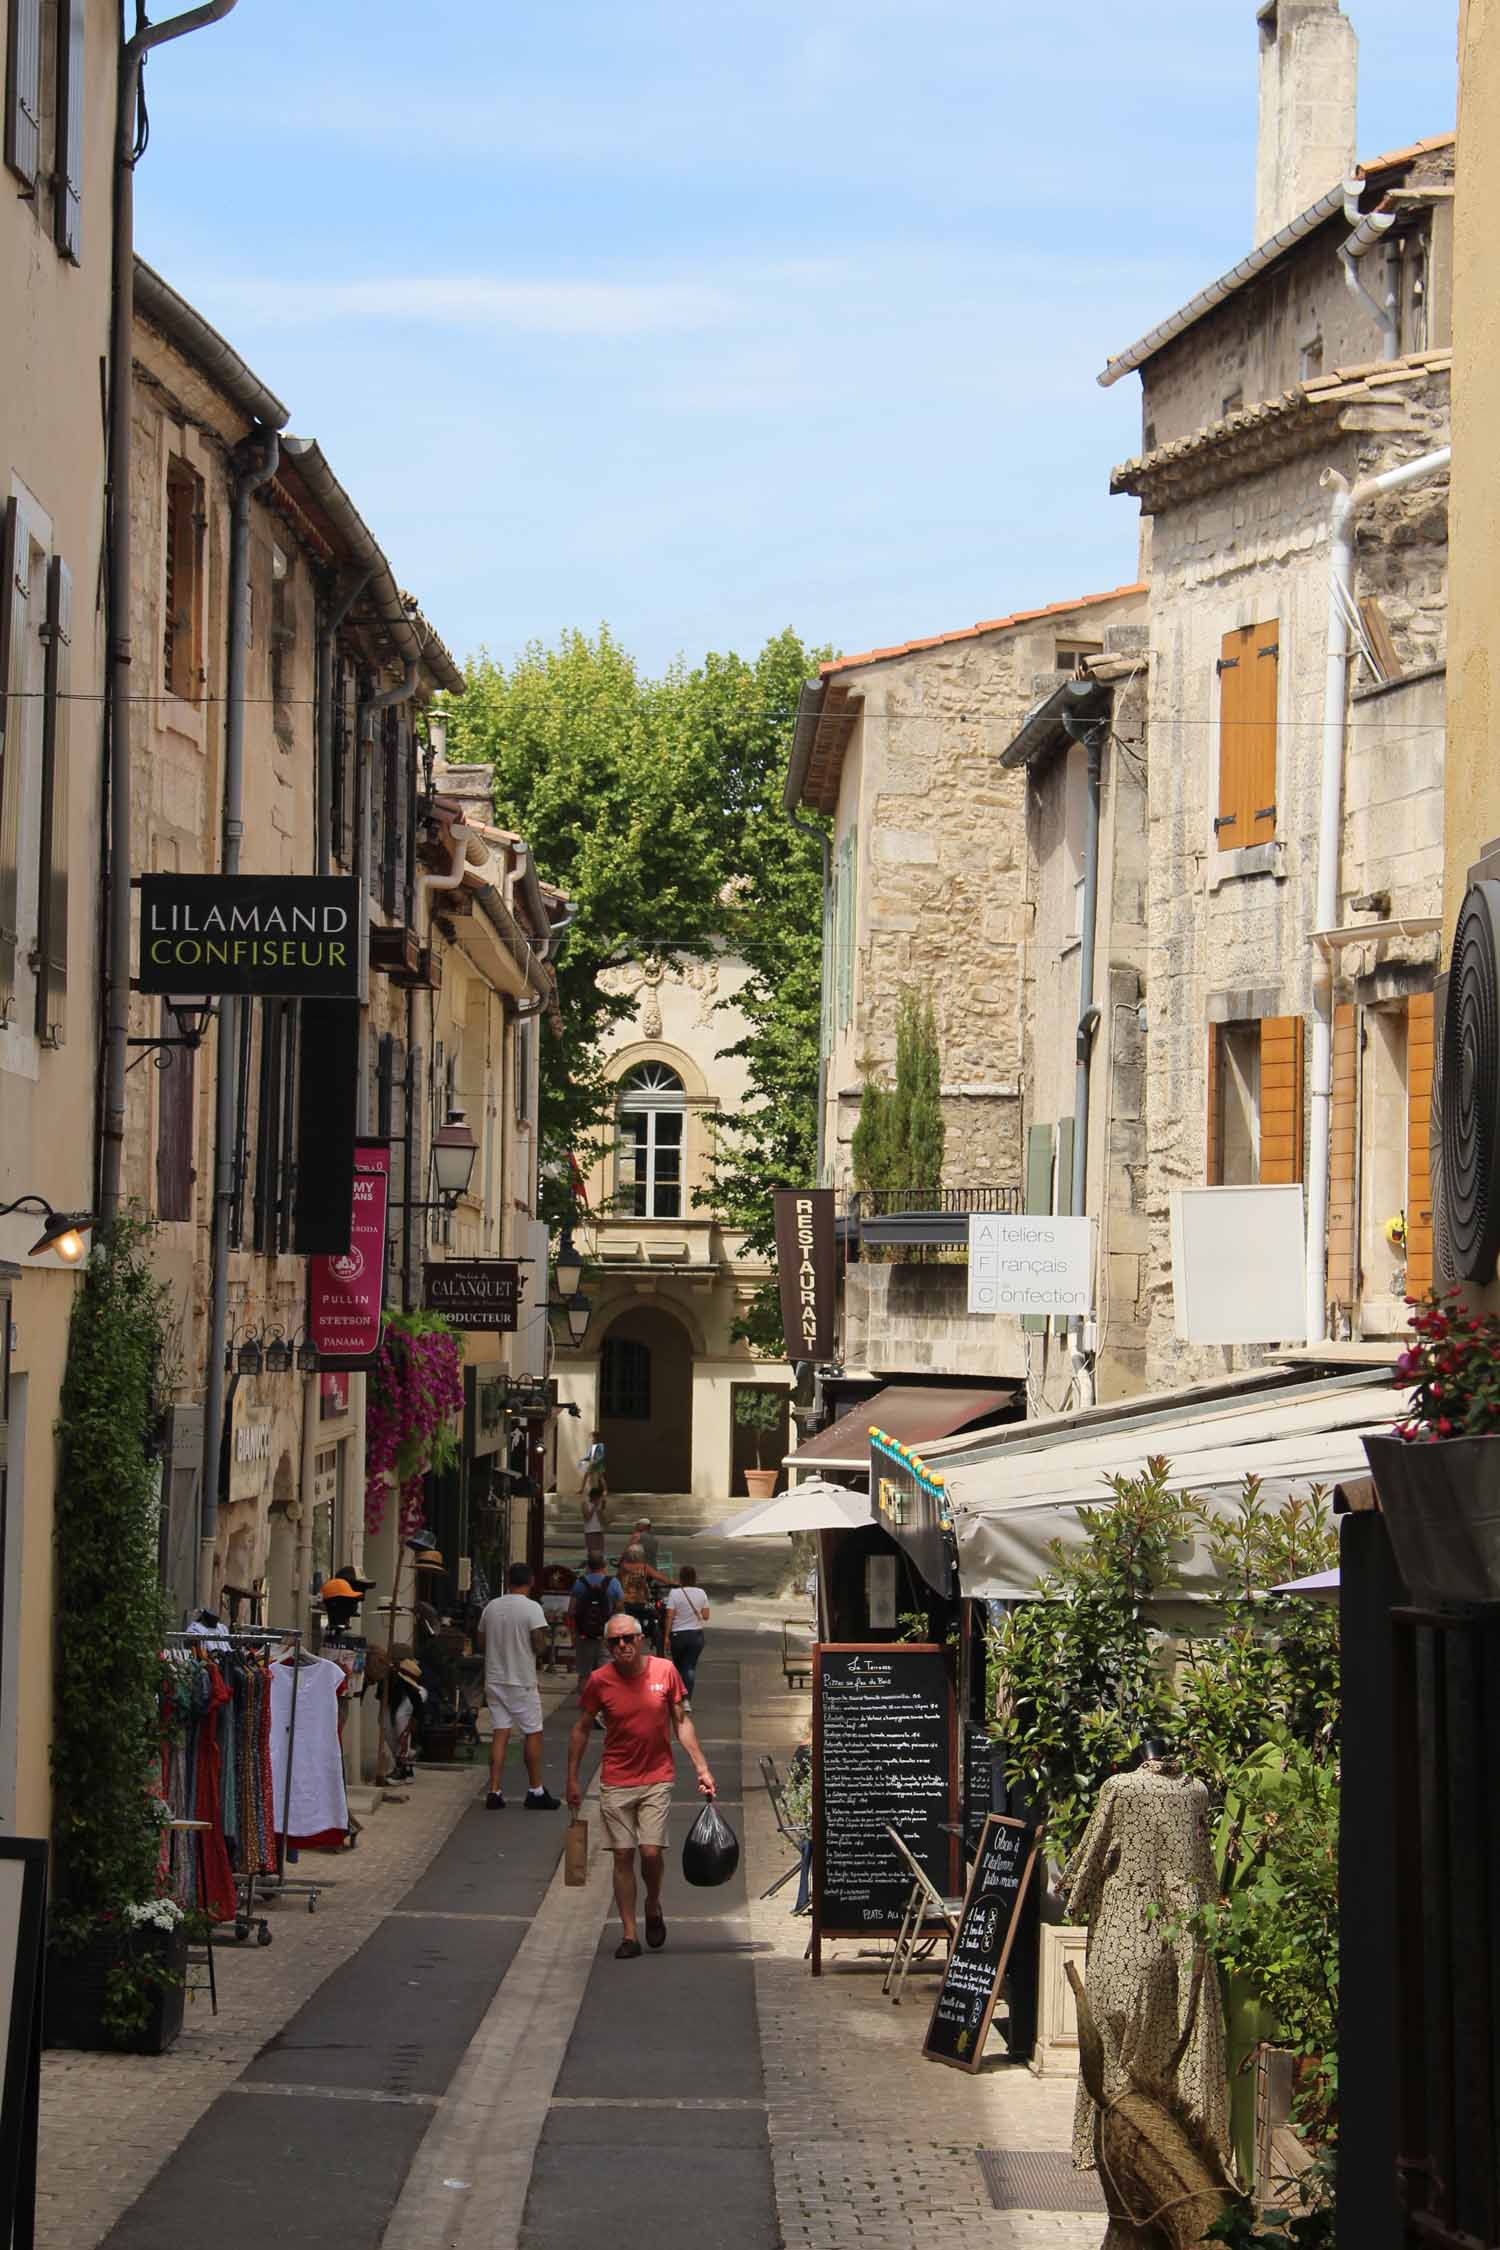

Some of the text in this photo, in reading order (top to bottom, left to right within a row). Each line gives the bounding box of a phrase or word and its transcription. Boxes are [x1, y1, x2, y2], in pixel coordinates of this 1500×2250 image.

[151, 904, 348, 933] LILAMAND
[151, 939, 347, 967] CONFISEUR
[796, 1199, 817, 1351] RESTAURANT
[432, 1280, 513, 1297] CALANQUET
[322, 1295, 369, 1304] PULLIN
[319, 1316, 371, 1326] STETSON
[323, 1337, 365, 1347] PANAMA
